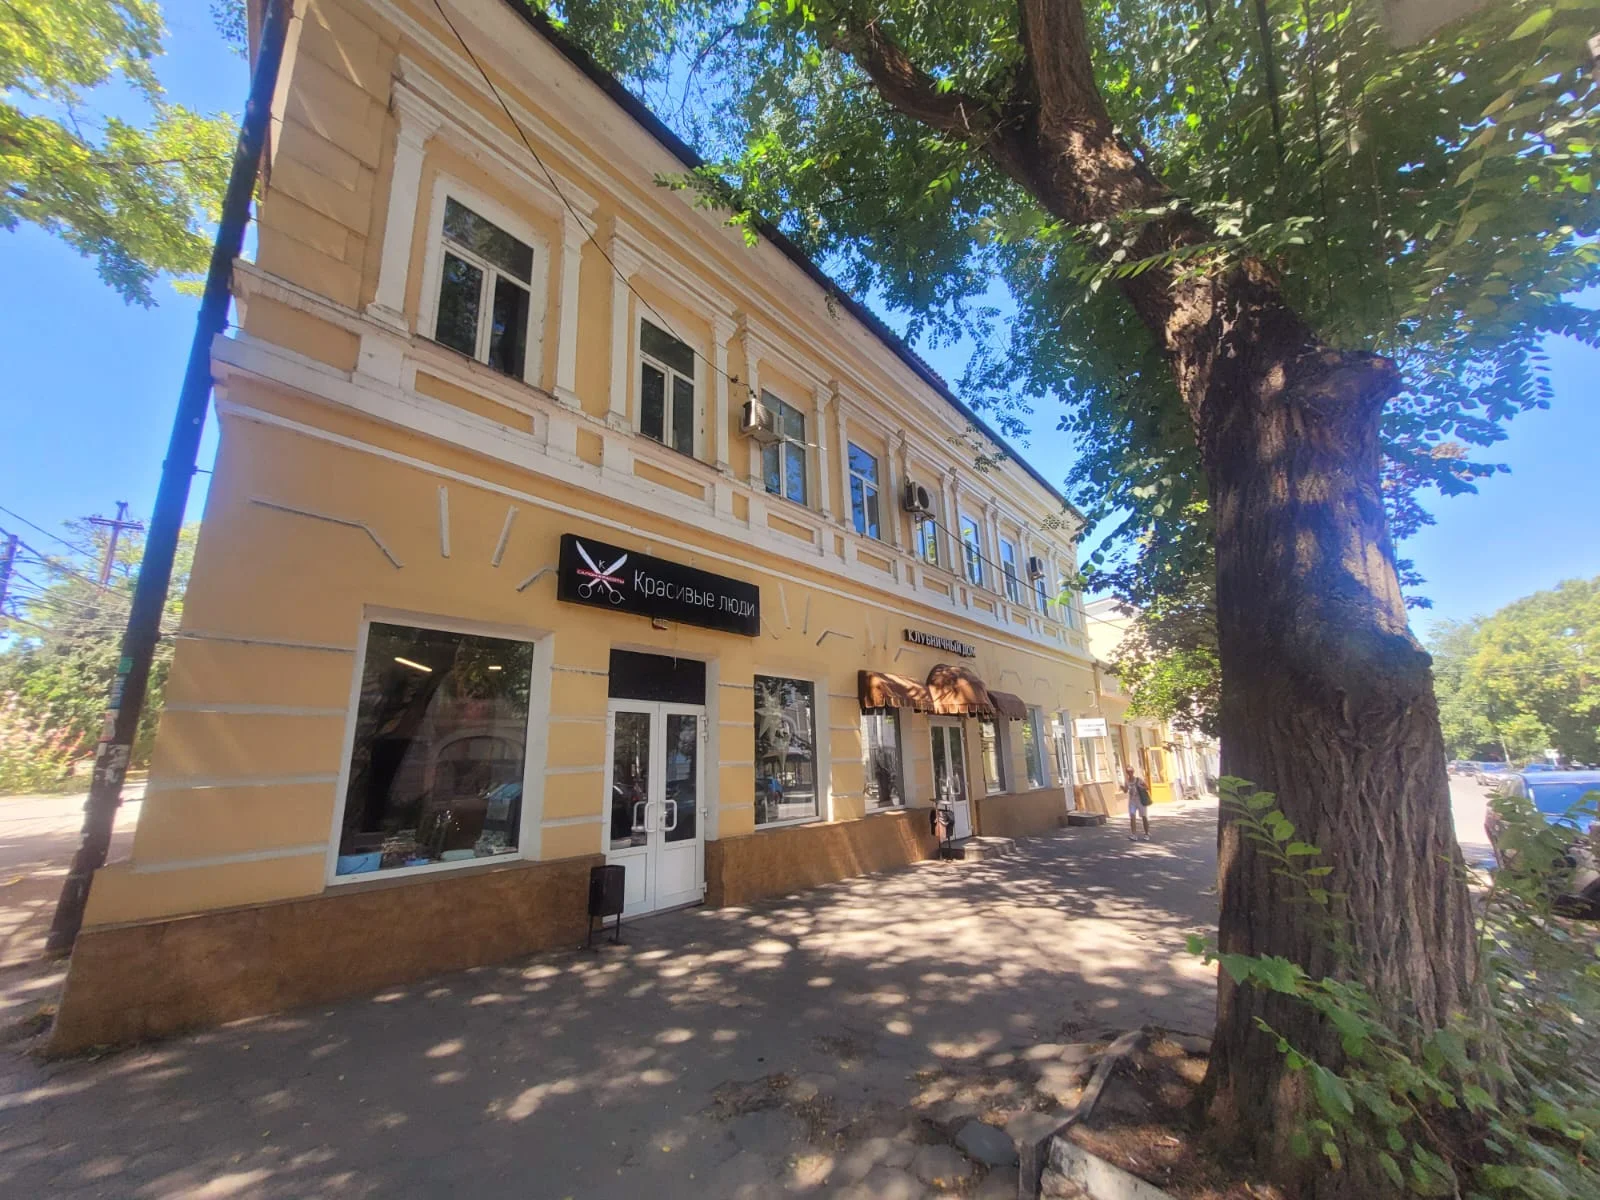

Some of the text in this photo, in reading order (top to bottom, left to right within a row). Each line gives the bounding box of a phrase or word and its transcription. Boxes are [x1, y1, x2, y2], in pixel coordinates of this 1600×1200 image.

[598, 559, 606, 569] К
[634, 569, 755, 617] Красивые люди
[906, 629, 961, 654] КЛУБНИЧНЫЙ
